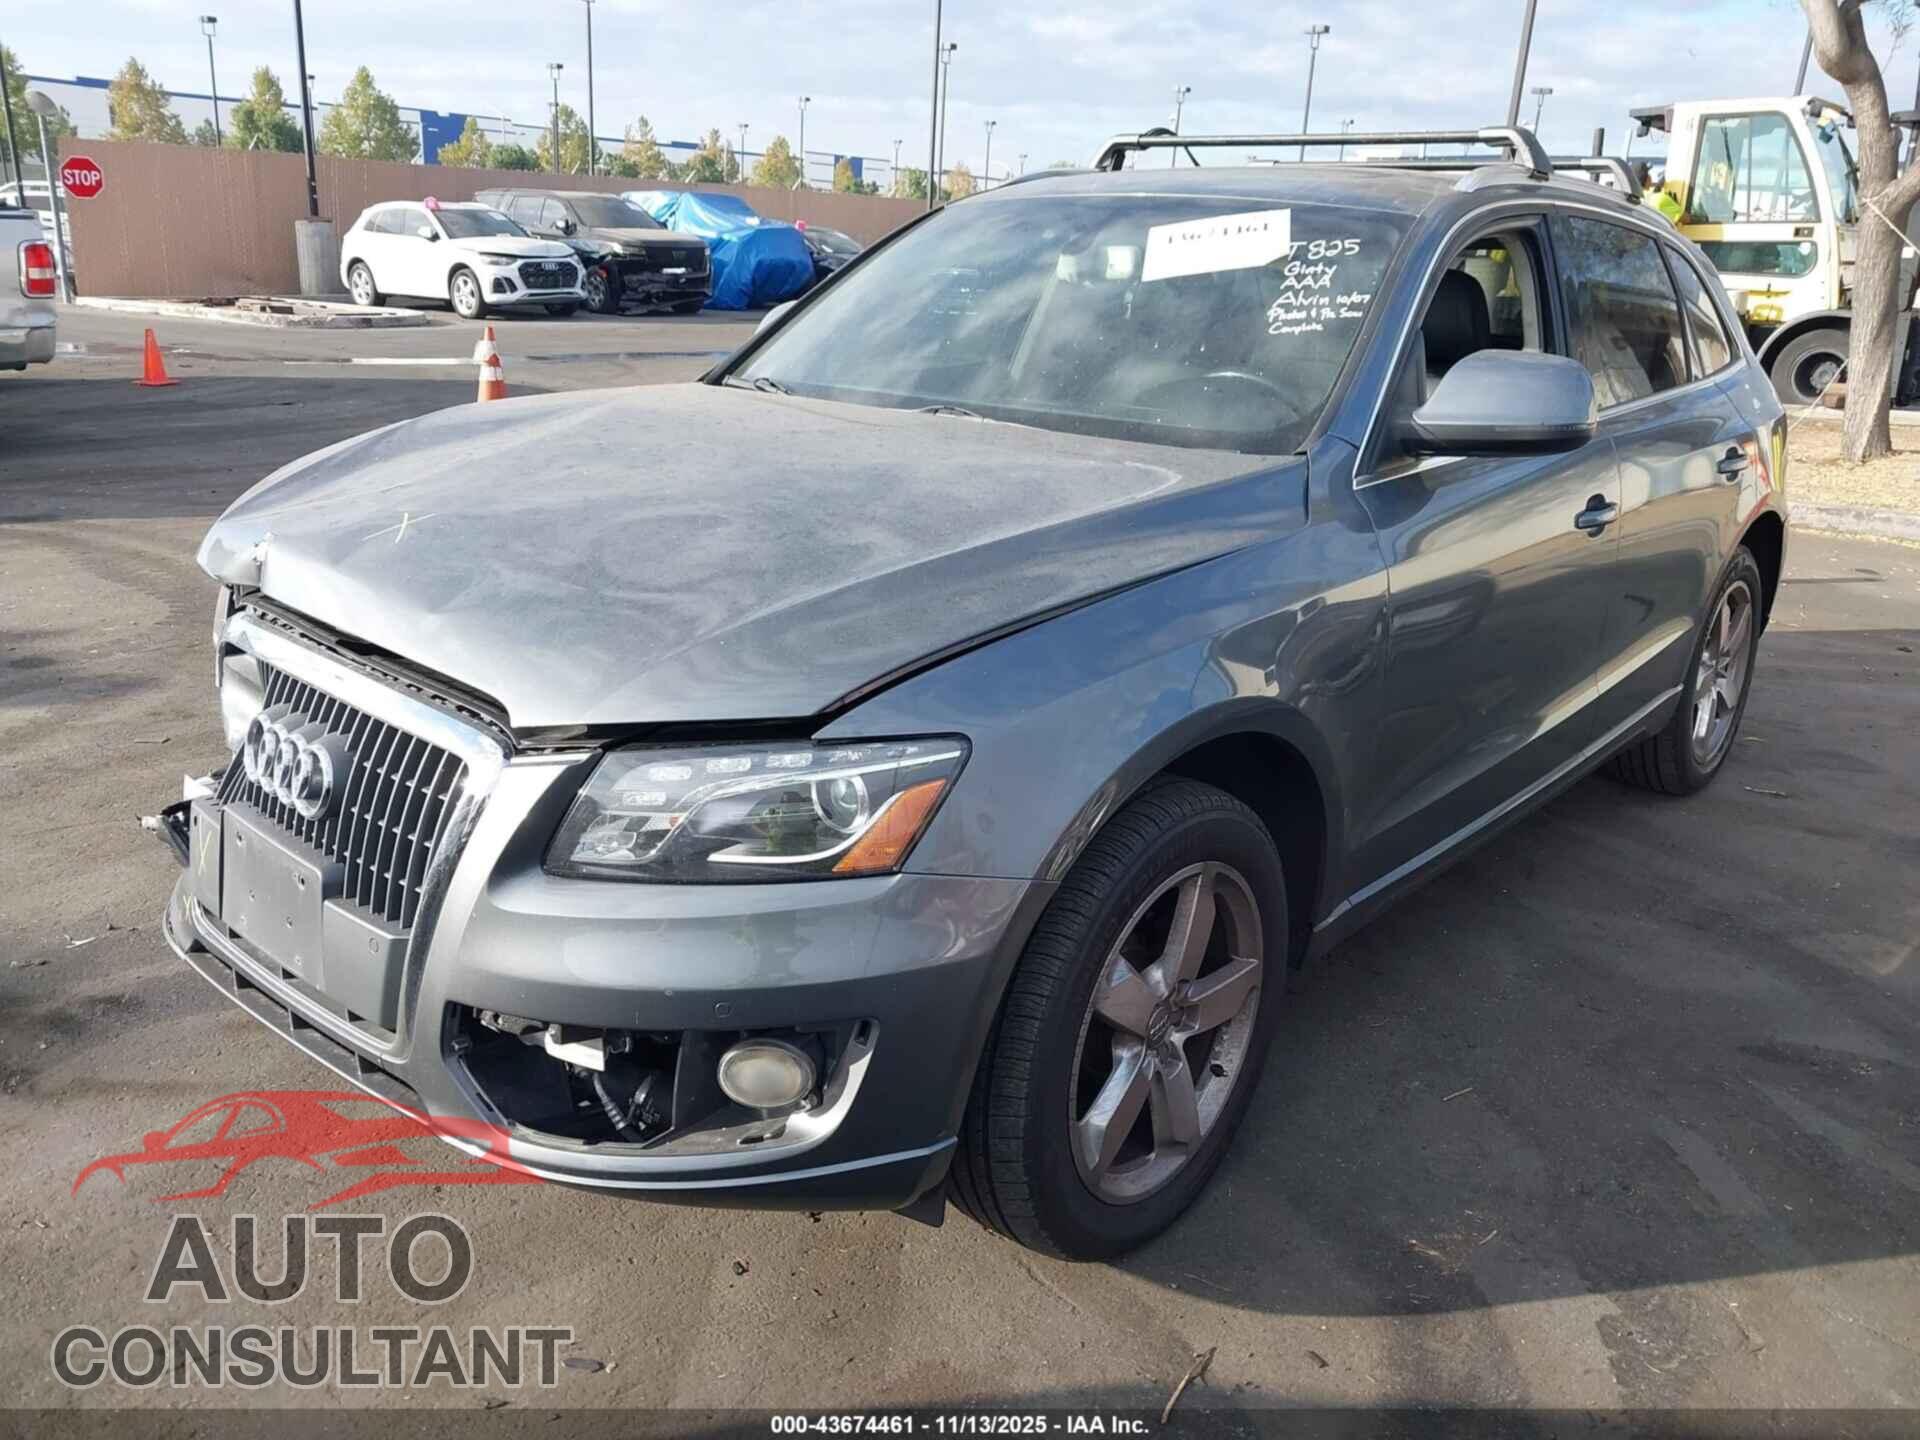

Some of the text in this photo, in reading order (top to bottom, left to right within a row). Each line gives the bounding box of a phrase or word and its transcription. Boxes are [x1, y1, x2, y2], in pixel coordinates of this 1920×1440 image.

[63, 169, 100, 186] STOP
[1280, 275, 1330, 290] AAA
[1272, 290, 1330, 308] Alvin
